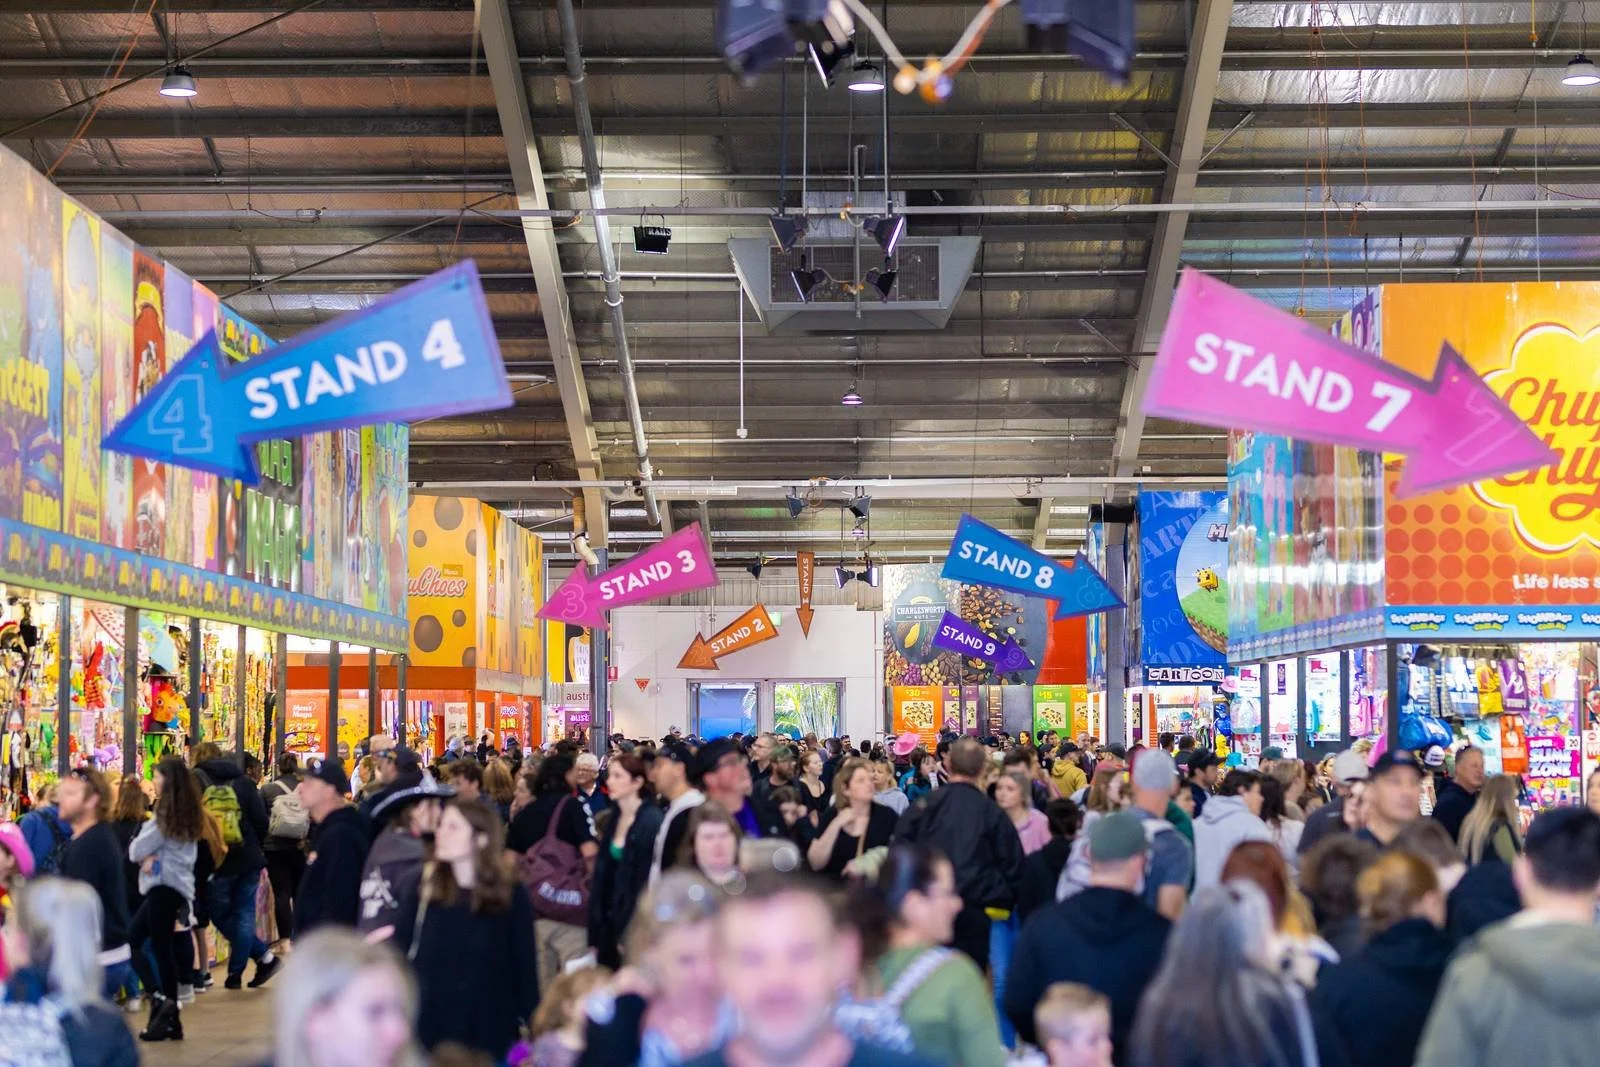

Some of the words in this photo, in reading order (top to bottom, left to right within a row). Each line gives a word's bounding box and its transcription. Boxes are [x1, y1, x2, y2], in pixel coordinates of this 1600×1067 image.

[245, 340, 407, 420] STAND
[423, 319, 466, 370] 4
[1188, 332, 1354, 413] STAND
[1365, 380, 1412, 433] 7
[148, 373, 213, 455] 4
[1501, 376, 1600, 443] Chu
[1207, 523, 1229, 542] M
[600, 560, 673, 600] STAND
[677, 550, 697, 573] 3
[958, 540, 1032, 579] STAND
[1034, 566, 1055, 589] 8
[1512, 574, 1549, 590] Life
[1552, 574, 1590, 589] less
[560, 583, 588, 620] 3
[896, 606, 946, 616] CHARLESWORTH
[711, 626, 751, 653] STAND
[752, 618, 766, 632] 2
[941, 625, 983, 649] STAND
[984, 642, 996, 656] 9
[1149, 669, 1224, 681] CARTOON
[1528, 762, 1573, 778] ZONE
